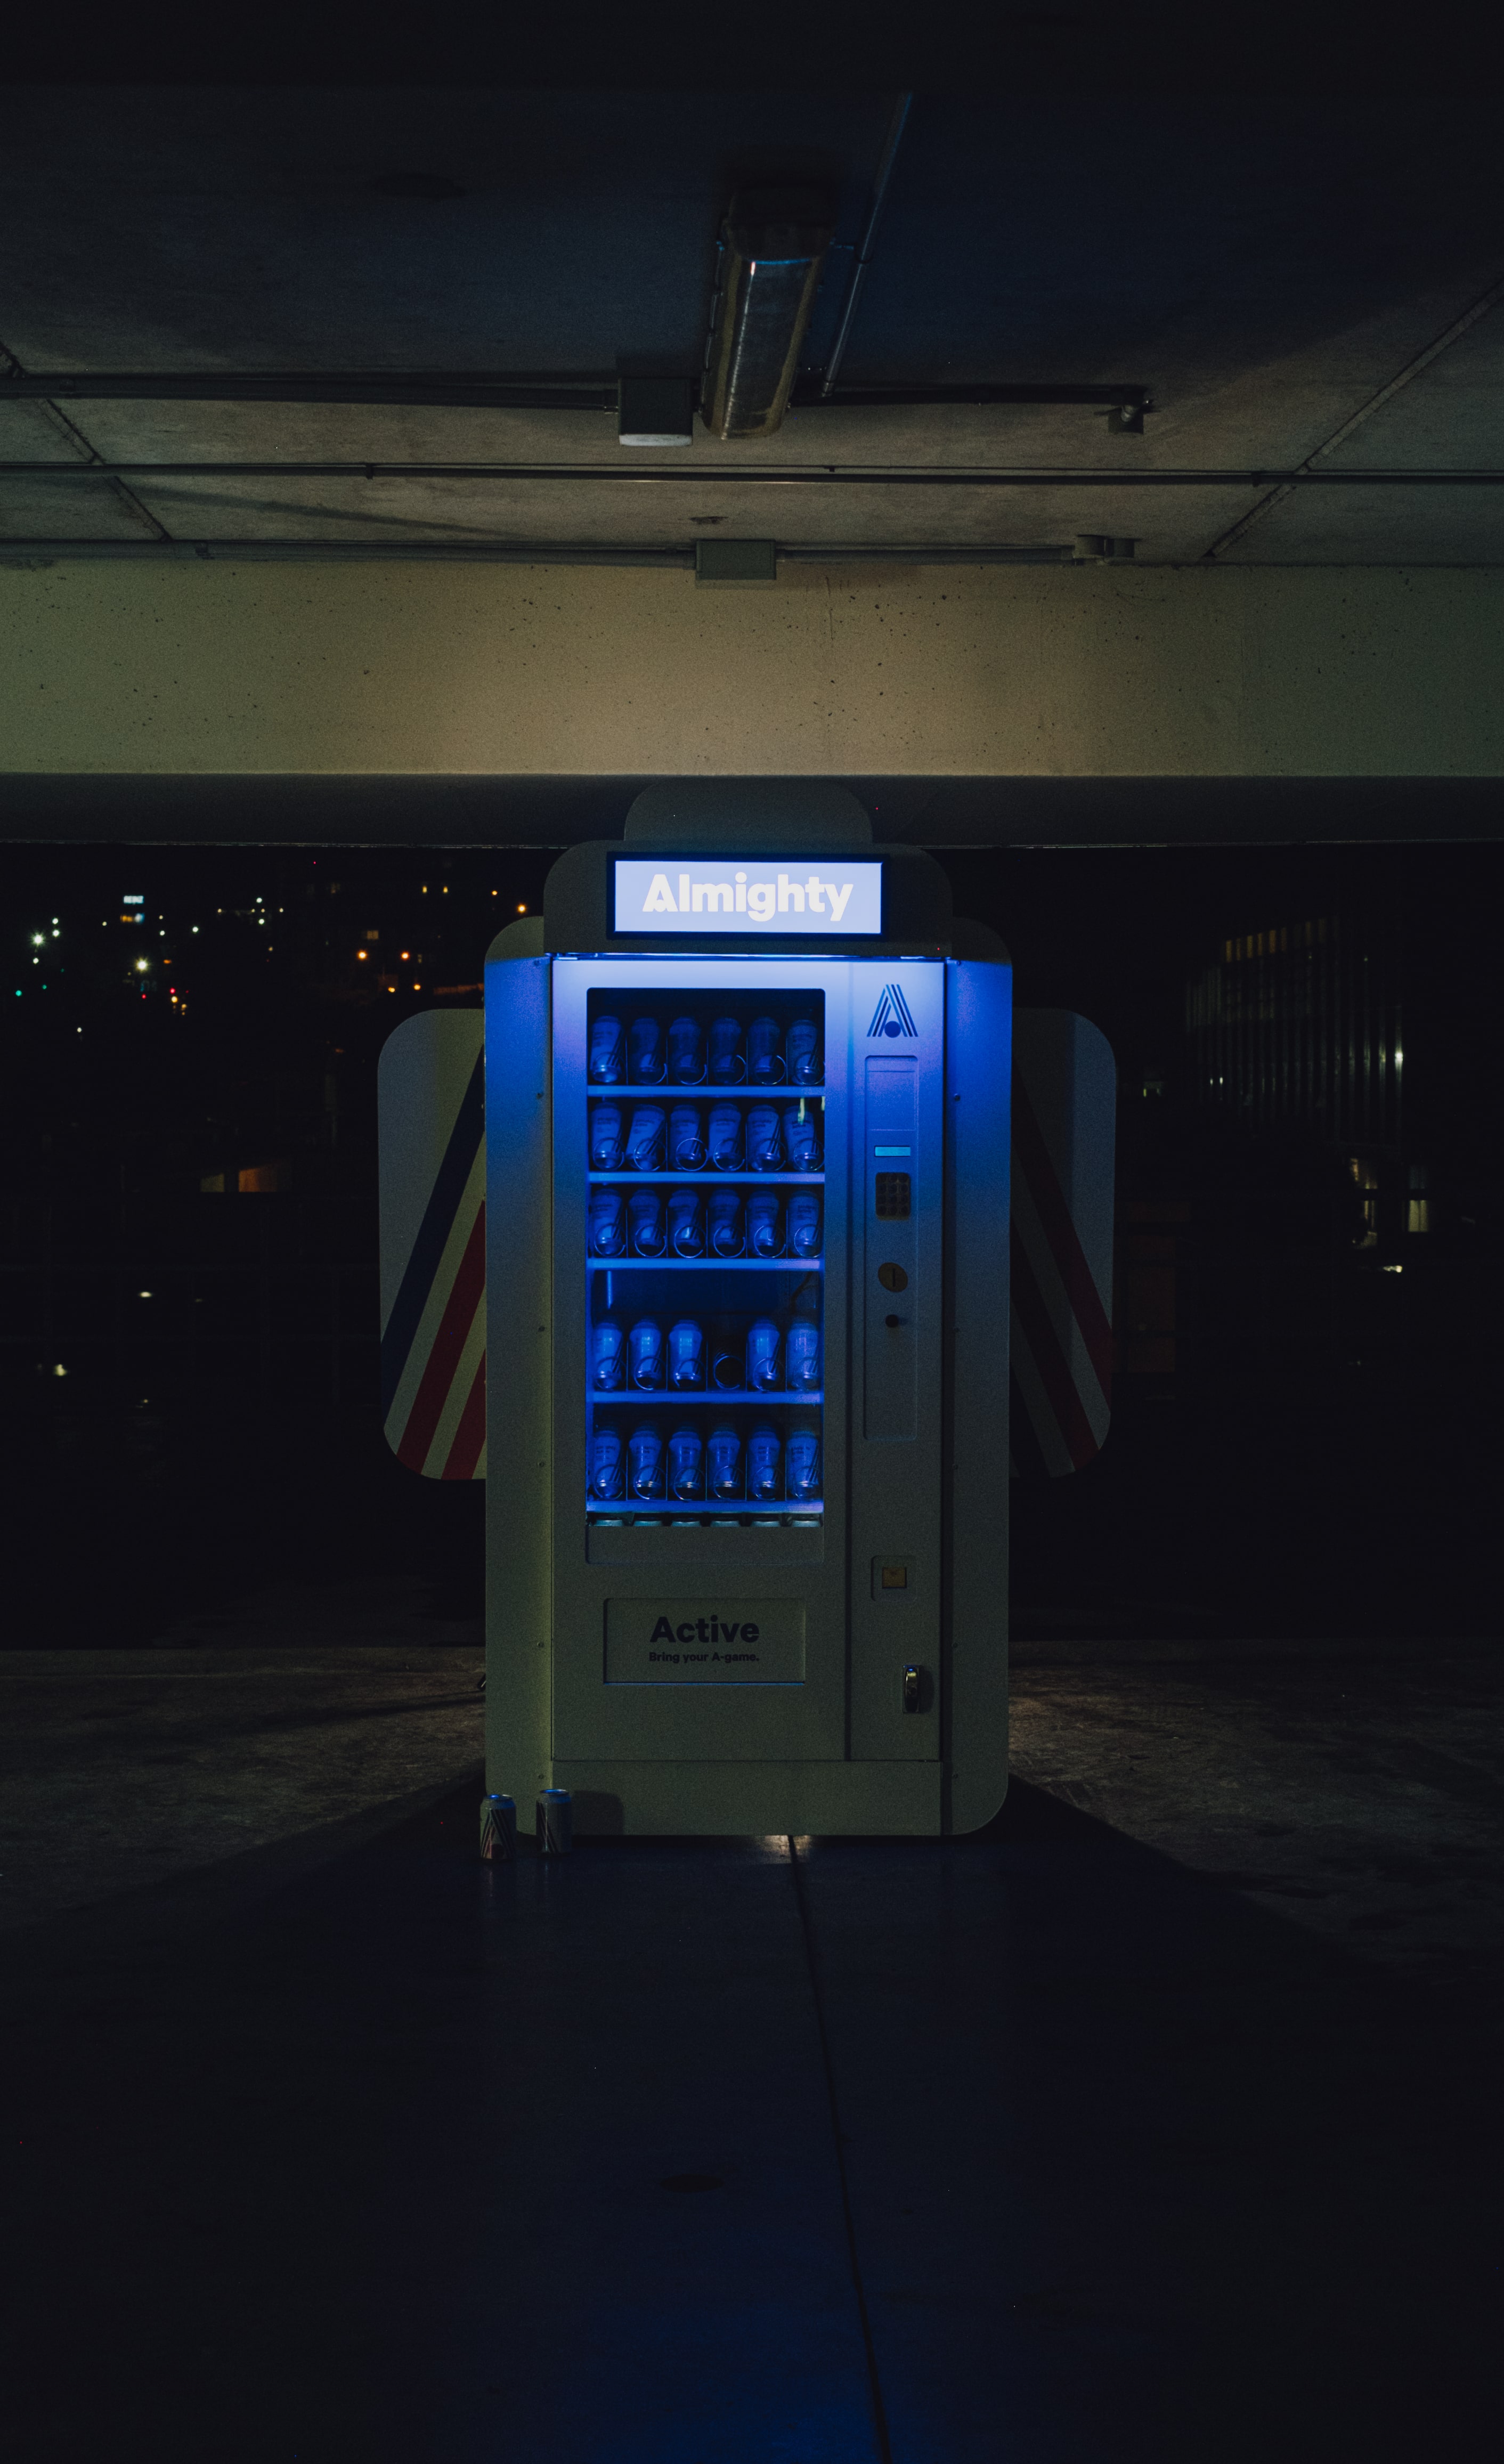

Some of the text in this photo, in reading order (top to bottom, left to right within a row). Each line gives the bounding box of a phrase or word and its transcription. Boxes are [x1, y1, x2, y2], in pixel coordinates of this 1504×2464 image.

[643, 872, 853, 922] Almighty
[649, 1614, 760, 1644] Active
[649, 1652, 760, 1664] Bring your A-game.
